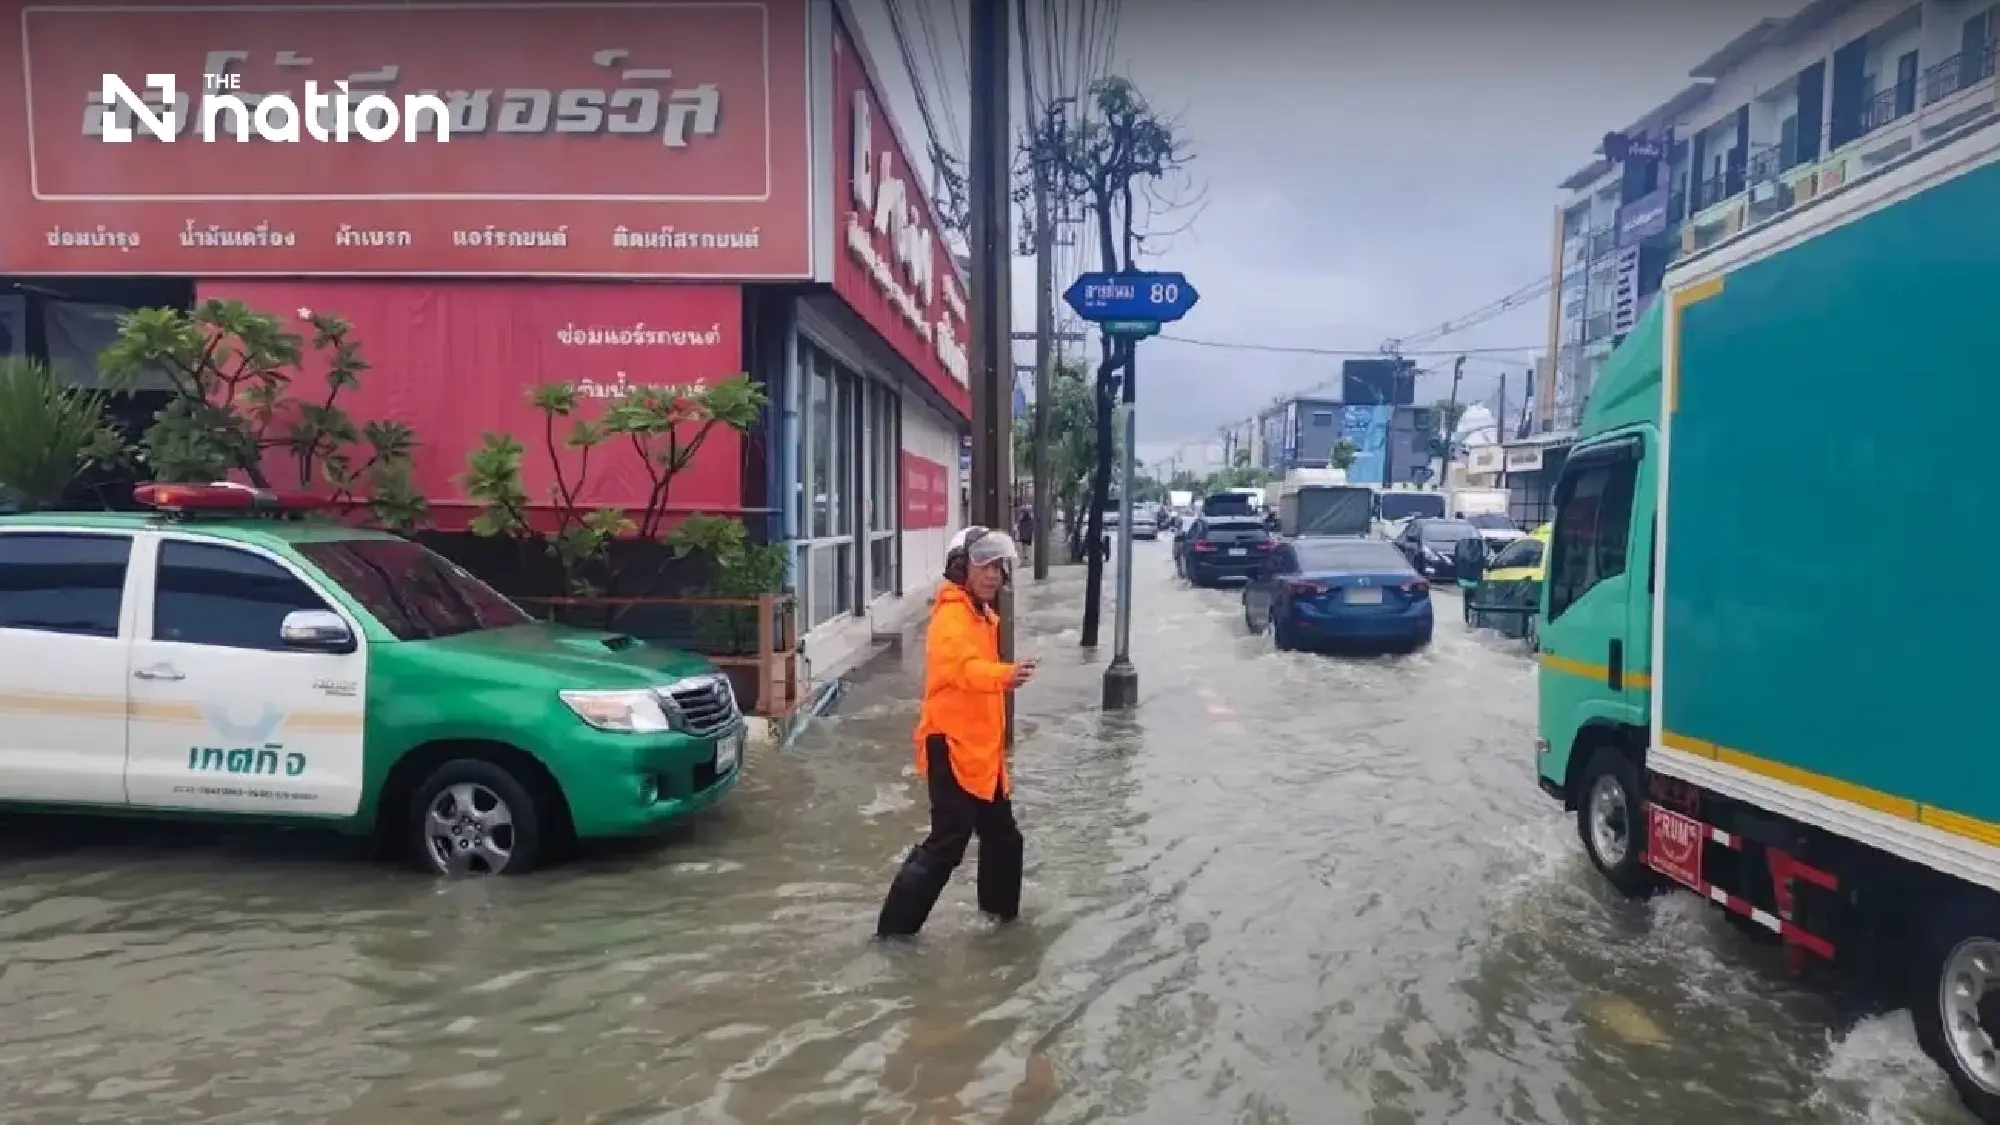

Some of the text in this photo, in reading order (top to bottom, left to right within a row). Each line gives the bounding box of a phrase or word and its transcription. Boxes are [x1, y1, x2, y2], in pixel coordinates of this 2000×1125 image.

[1150, 283, 1178, 303] 80
[189, 743, 307, 777] เทศกิจ
